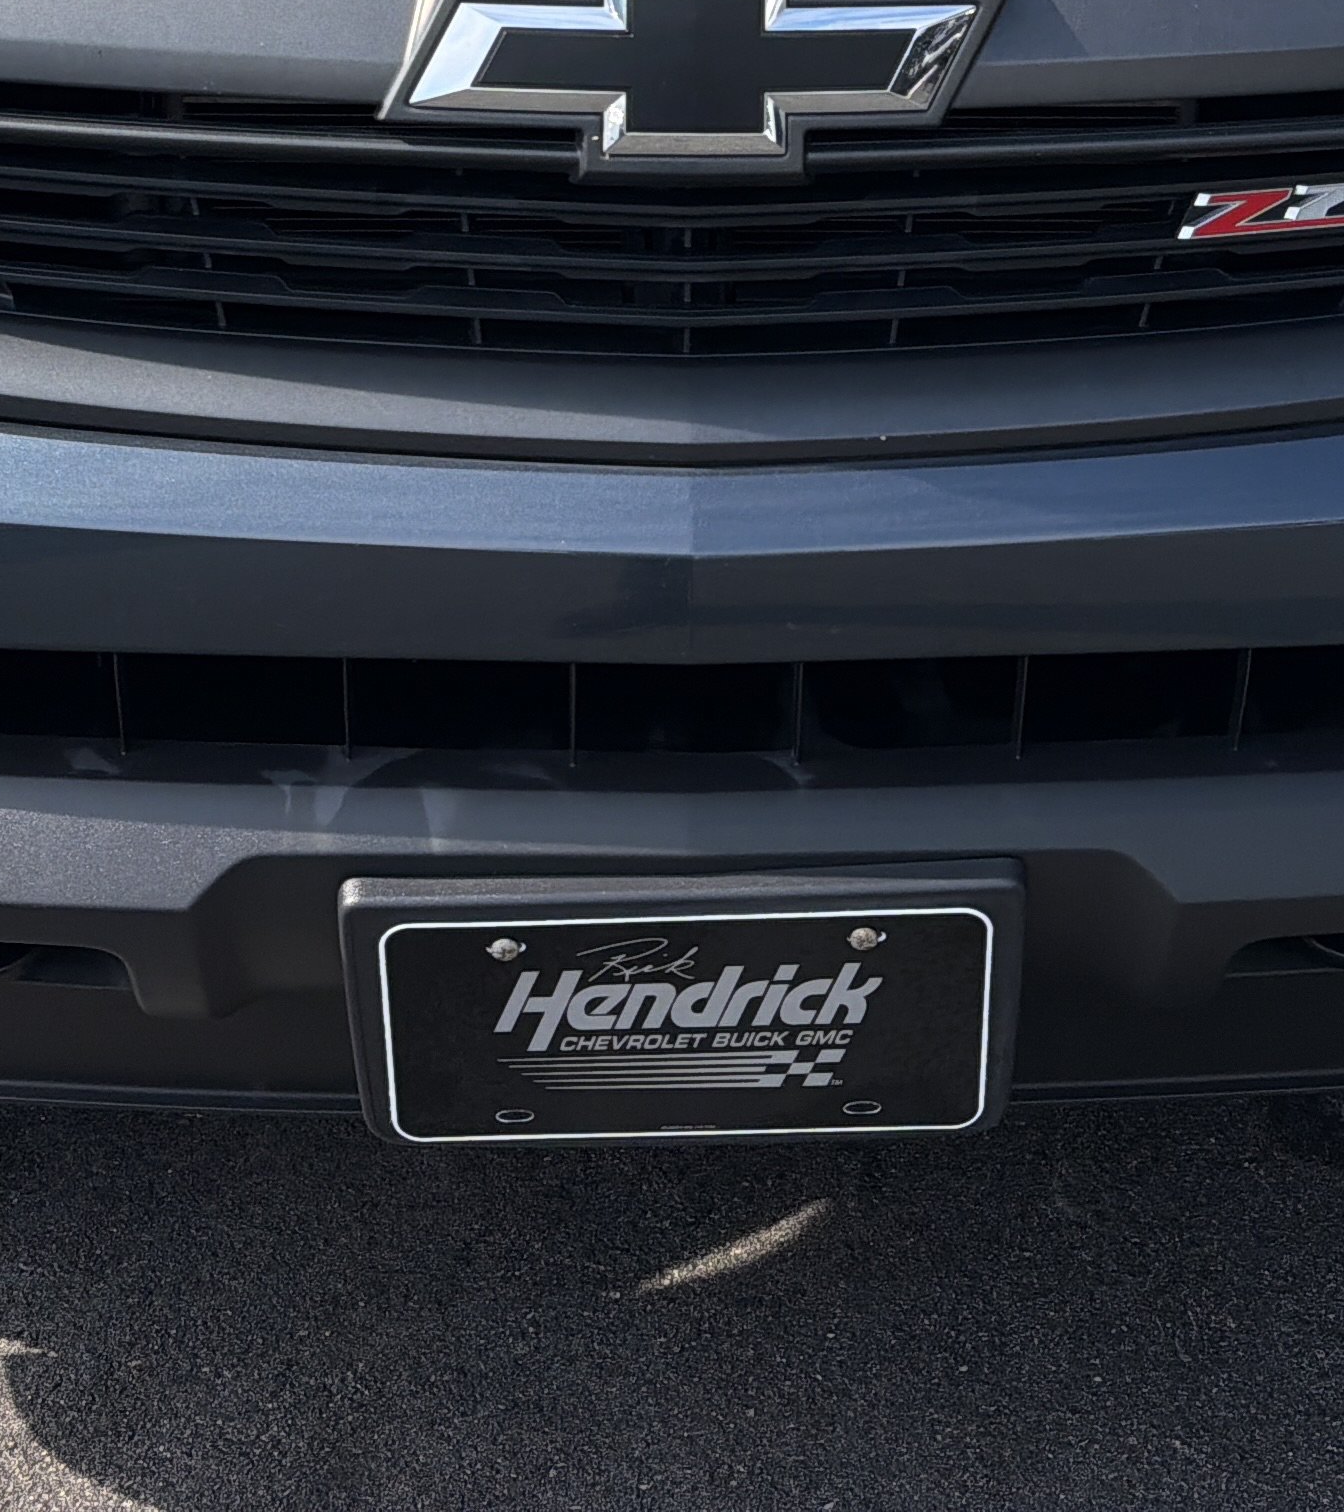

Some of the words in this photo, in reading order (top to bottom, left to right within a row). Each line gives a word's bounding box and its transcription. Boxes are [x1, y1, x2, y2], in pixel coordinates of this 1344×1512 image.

[493, 962, 884, 1052] Hendrick
[559, 1032, 708, 1053] CHEVROLET
[711, 1031, 790, 1048] BUICK
[794, 1029, 854, 1047] GMC
